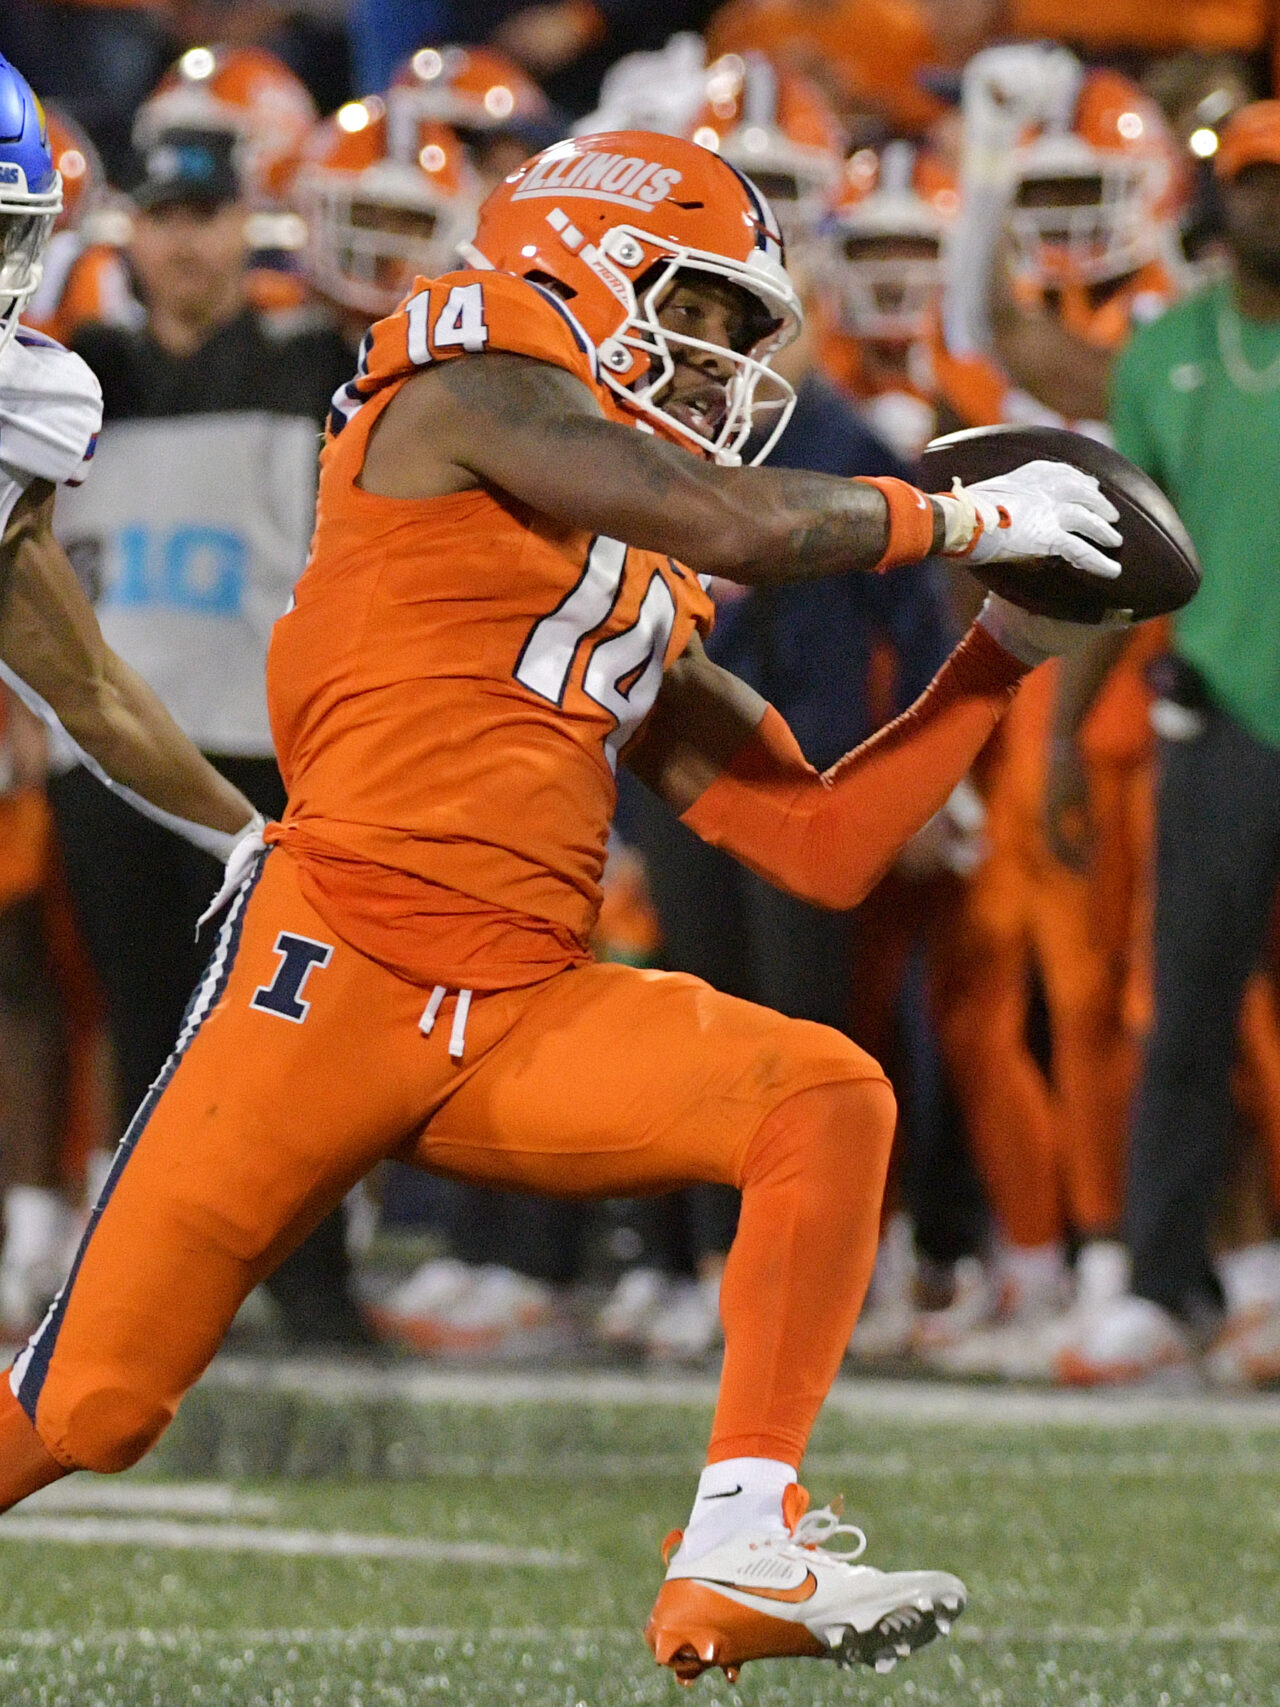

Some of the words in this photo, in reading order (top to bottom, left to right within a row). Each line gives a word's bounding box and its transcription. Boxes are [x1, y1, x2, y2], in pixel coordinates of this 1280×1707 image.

[514, 151, 684, 204] ILLINOIS
[404, 275, 490, 366] 14
[511, 533, 677, 780] 14
